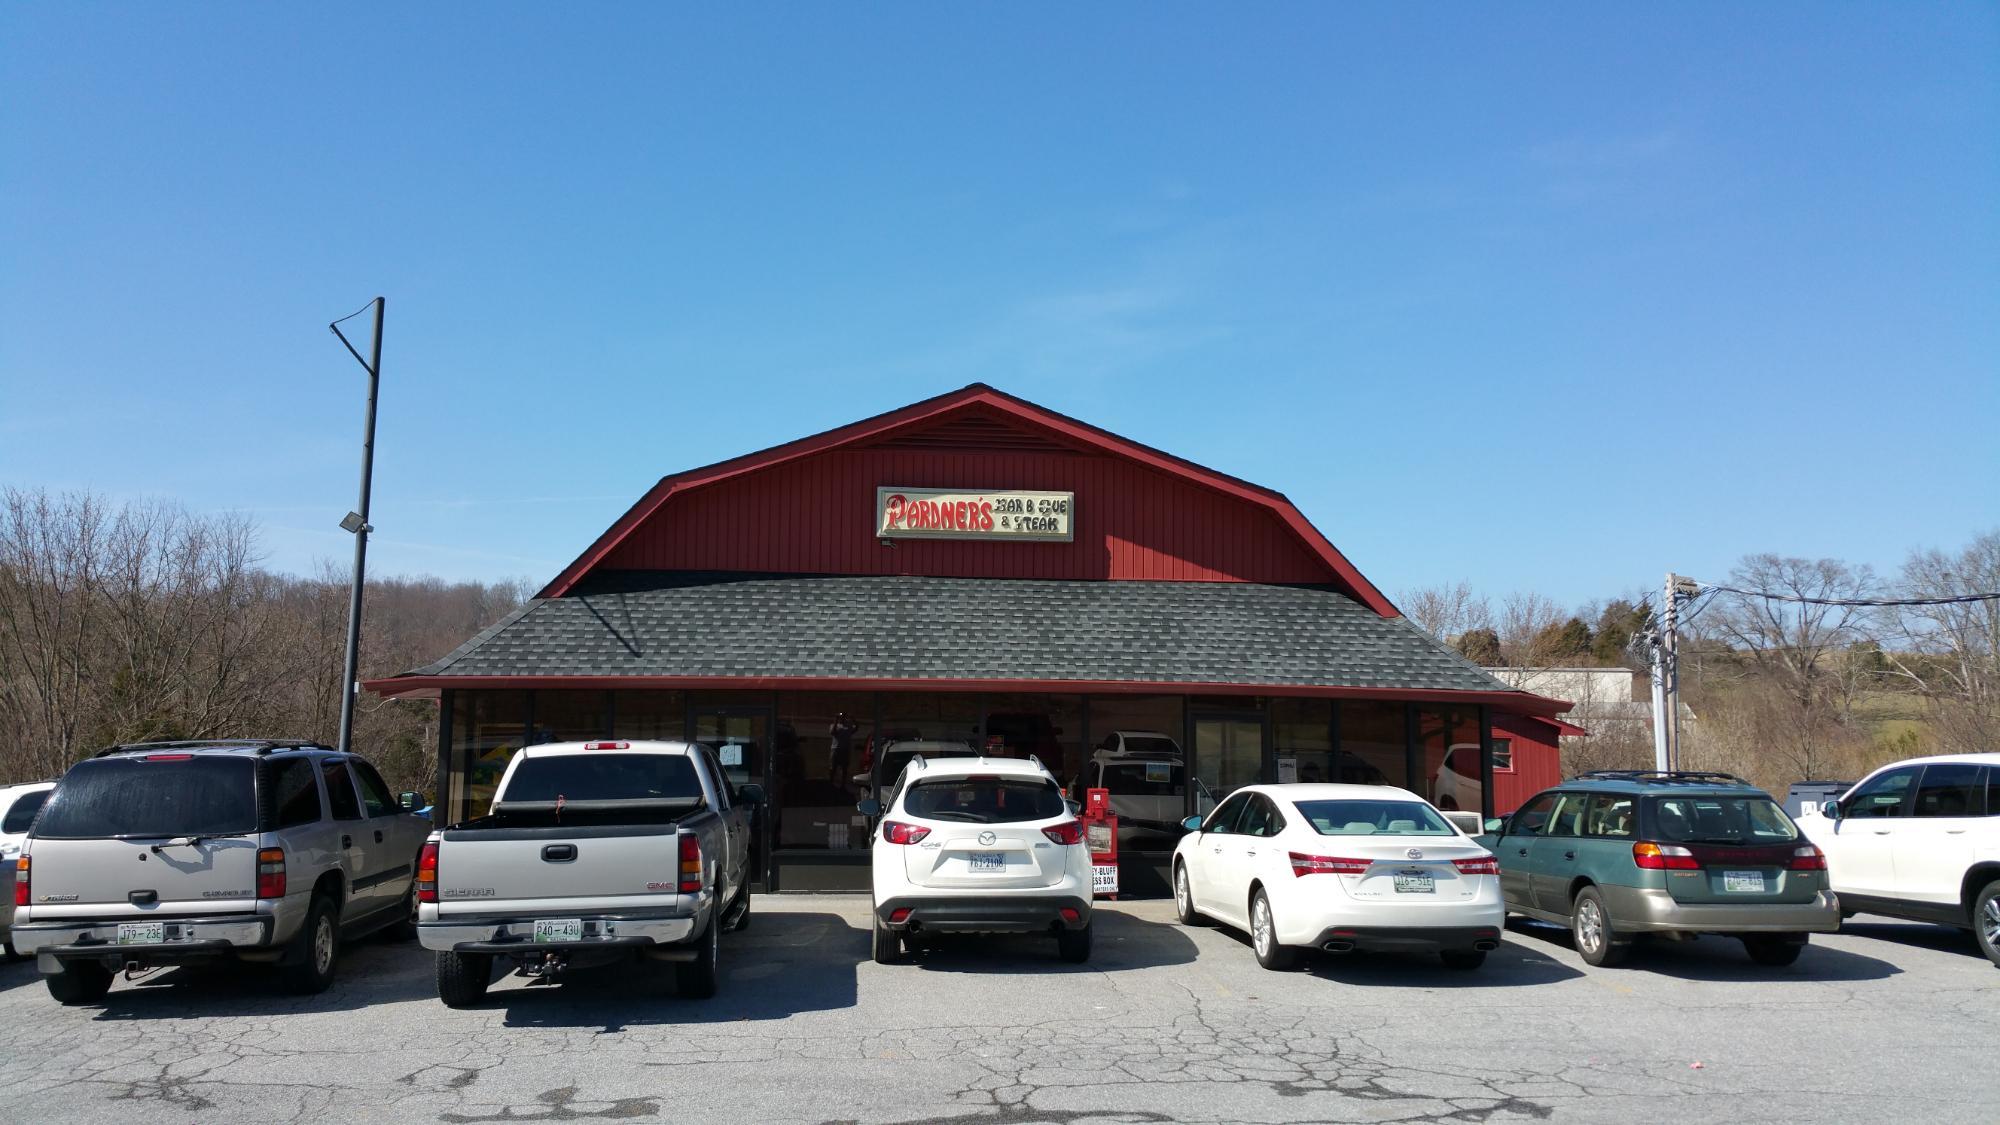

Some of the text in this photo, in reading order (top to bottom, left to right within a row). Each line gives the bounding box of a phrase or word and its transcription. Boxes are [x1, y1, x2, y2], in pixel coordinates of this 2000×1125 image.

[886, 494, 994, 530] PARDNER'S
[995, 498, 1067, 515] BAR B QUE
[1001, 516, 1059, 531] & STEAK
[1103, 876, 1115, 885] BOX
[120, 929, 162, 940] J79-23E
[536, 925, 579, 937] P40-43U
